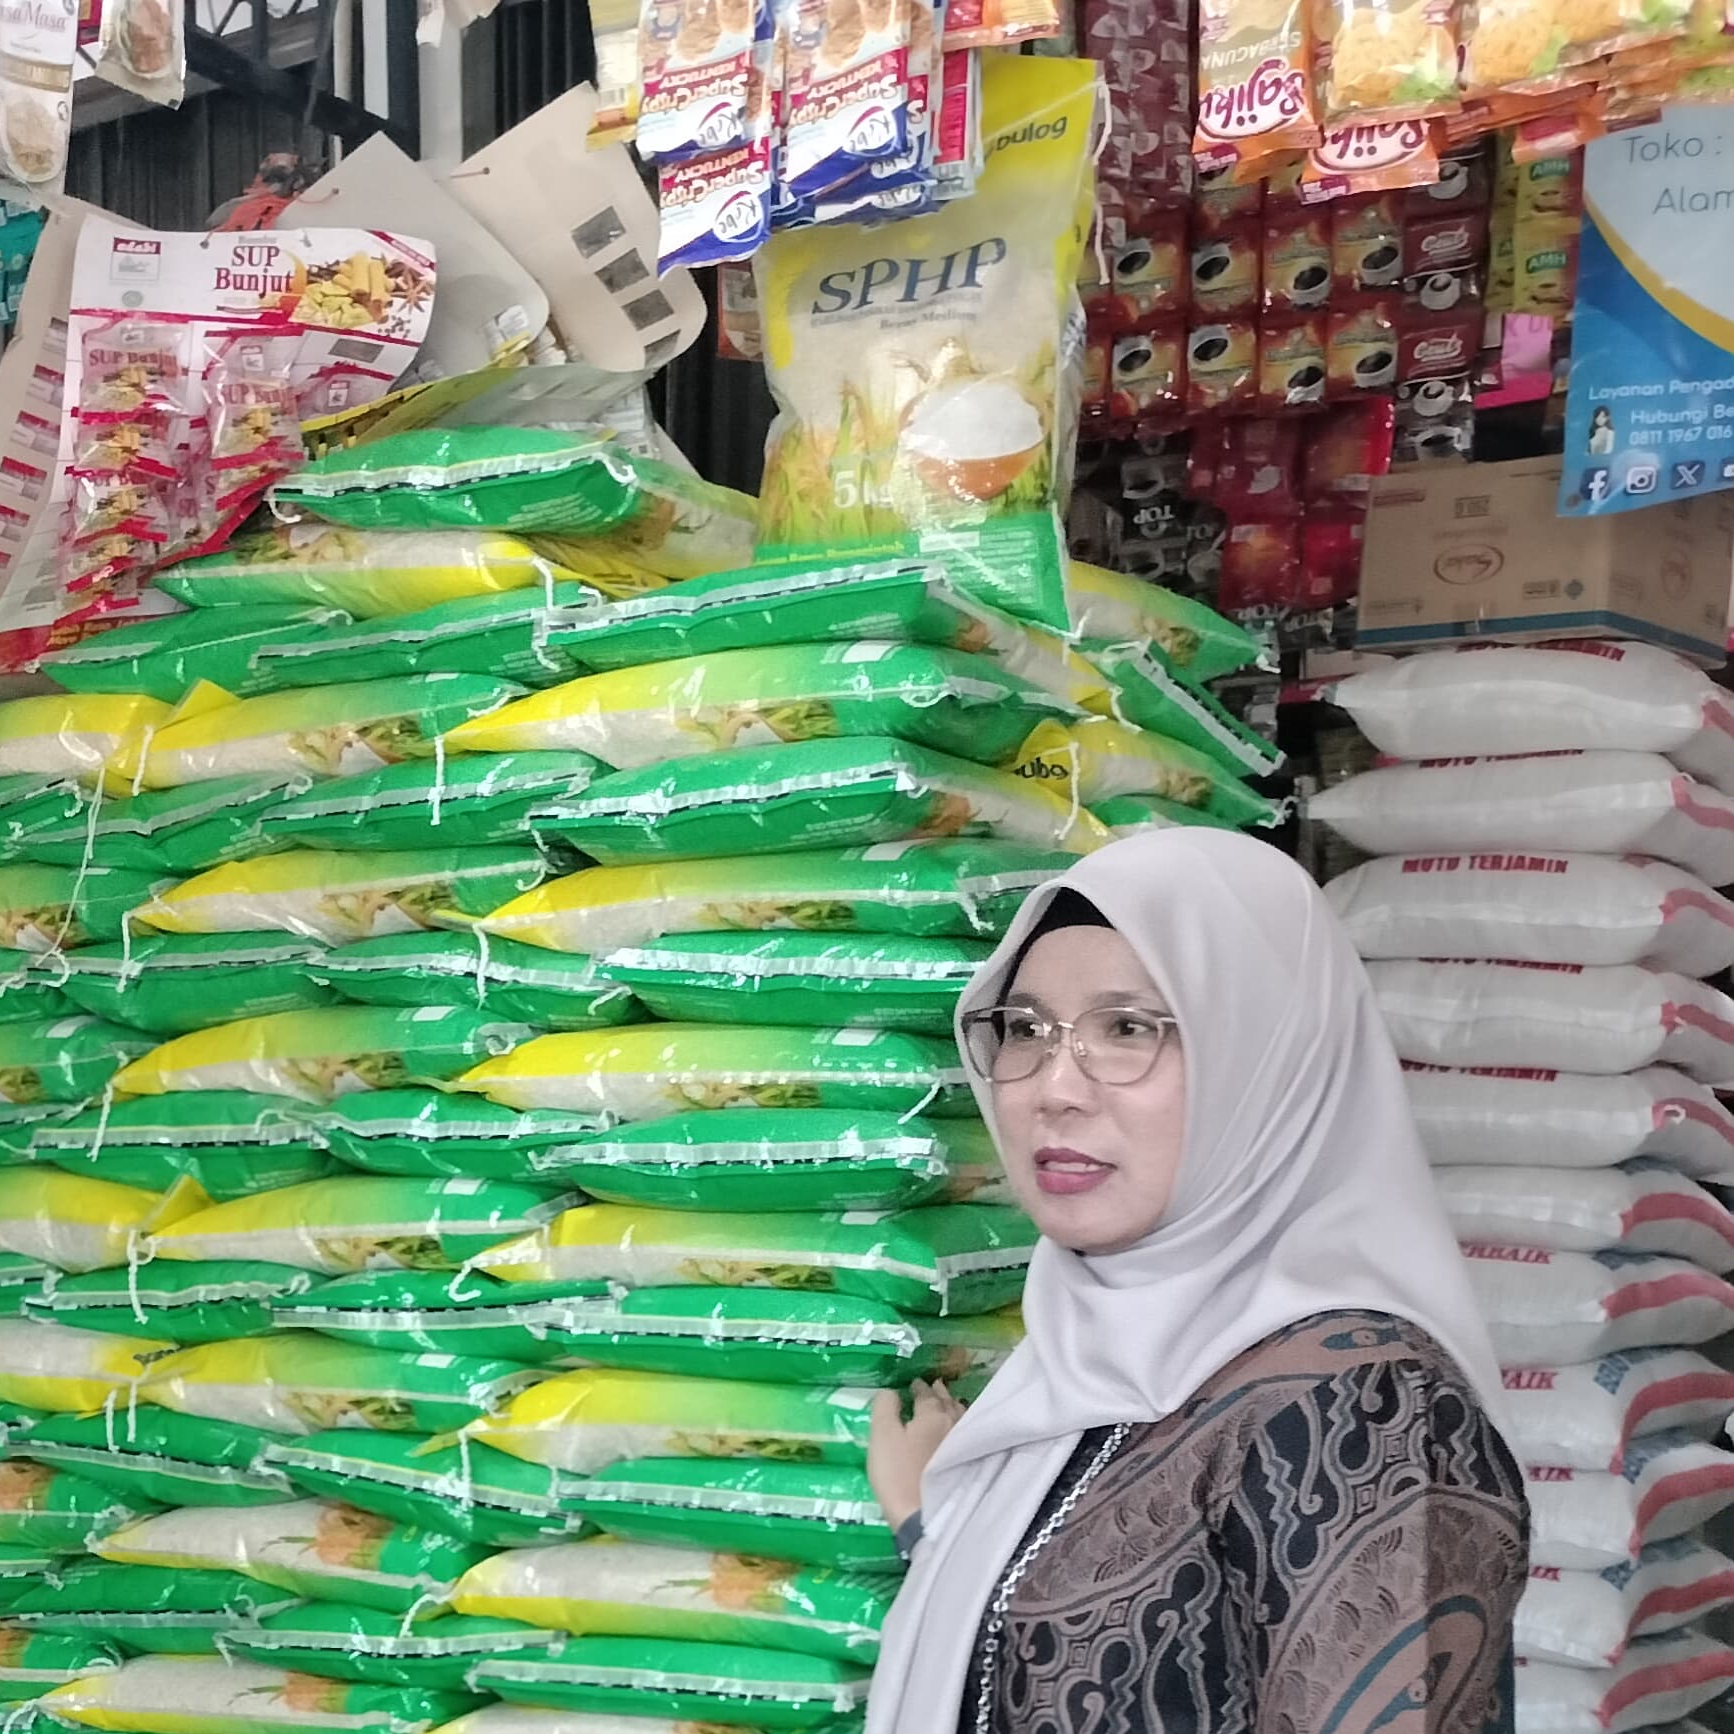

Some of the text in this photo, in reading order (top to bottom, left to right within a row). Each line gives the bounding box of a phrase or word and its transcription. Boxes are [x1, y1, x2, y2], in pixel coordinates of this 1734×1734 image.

[1624, 132, 1704, 165] Toko
[232, 246, 280, 268] SUP
[214, 268, 295, 299] Bunjut
[811, 237, 1007, 314] SPHP
[1589, 383, 1663, 401] Layanan
[1630, 407, 1709, 426] Hubungi
[1668, 427, 1702, 444] 1967
[834, 469, 858, 509] 5
[1401, 854, 1569, 874] MUTU TERJAMIN
